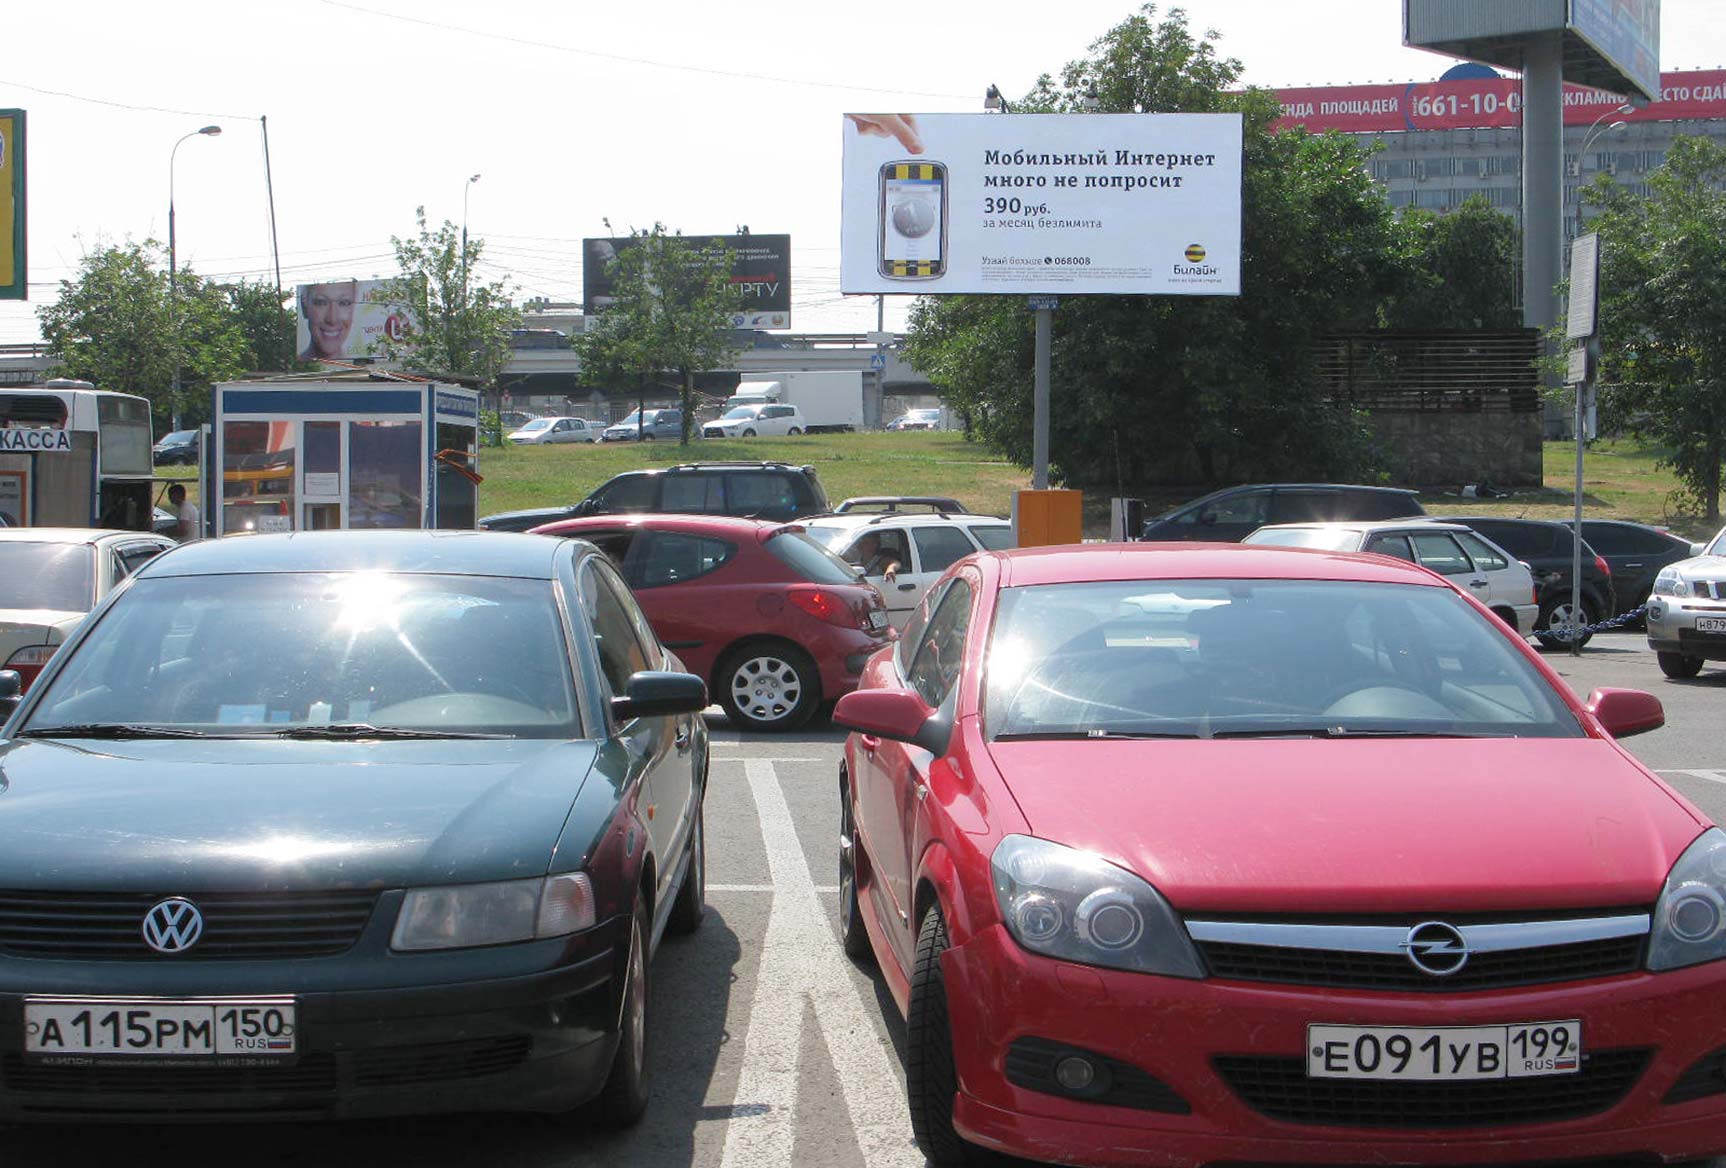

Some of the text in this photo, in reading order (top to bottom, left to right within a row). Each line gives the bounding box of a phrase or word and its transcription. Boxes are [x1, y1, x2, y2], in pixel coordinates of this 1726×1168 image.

[1321, 97, 1398, 116] ПЛОЩАДЕЙ
[984, 149, 1216, 169] Мобильный Интернет
[983, 175, 1183, 191] много не попросит
[984, 197, 1051, 216] 390 руб.
[983, 217, 1102, 230] за месяц безлимита
[1054, 257, 1091, 265] 068008
[1173, 264, 1217, 275] Билайн
[0, 430, 70, 449] КАССА
[40, 1008, 284, 1049] А115РМ 150
[234, 1038, 266, 1049] RUS
[1325, 1026, 1570, 1074] Е091УВ 199
[1524, 1059, 1554, 1071] RUS
